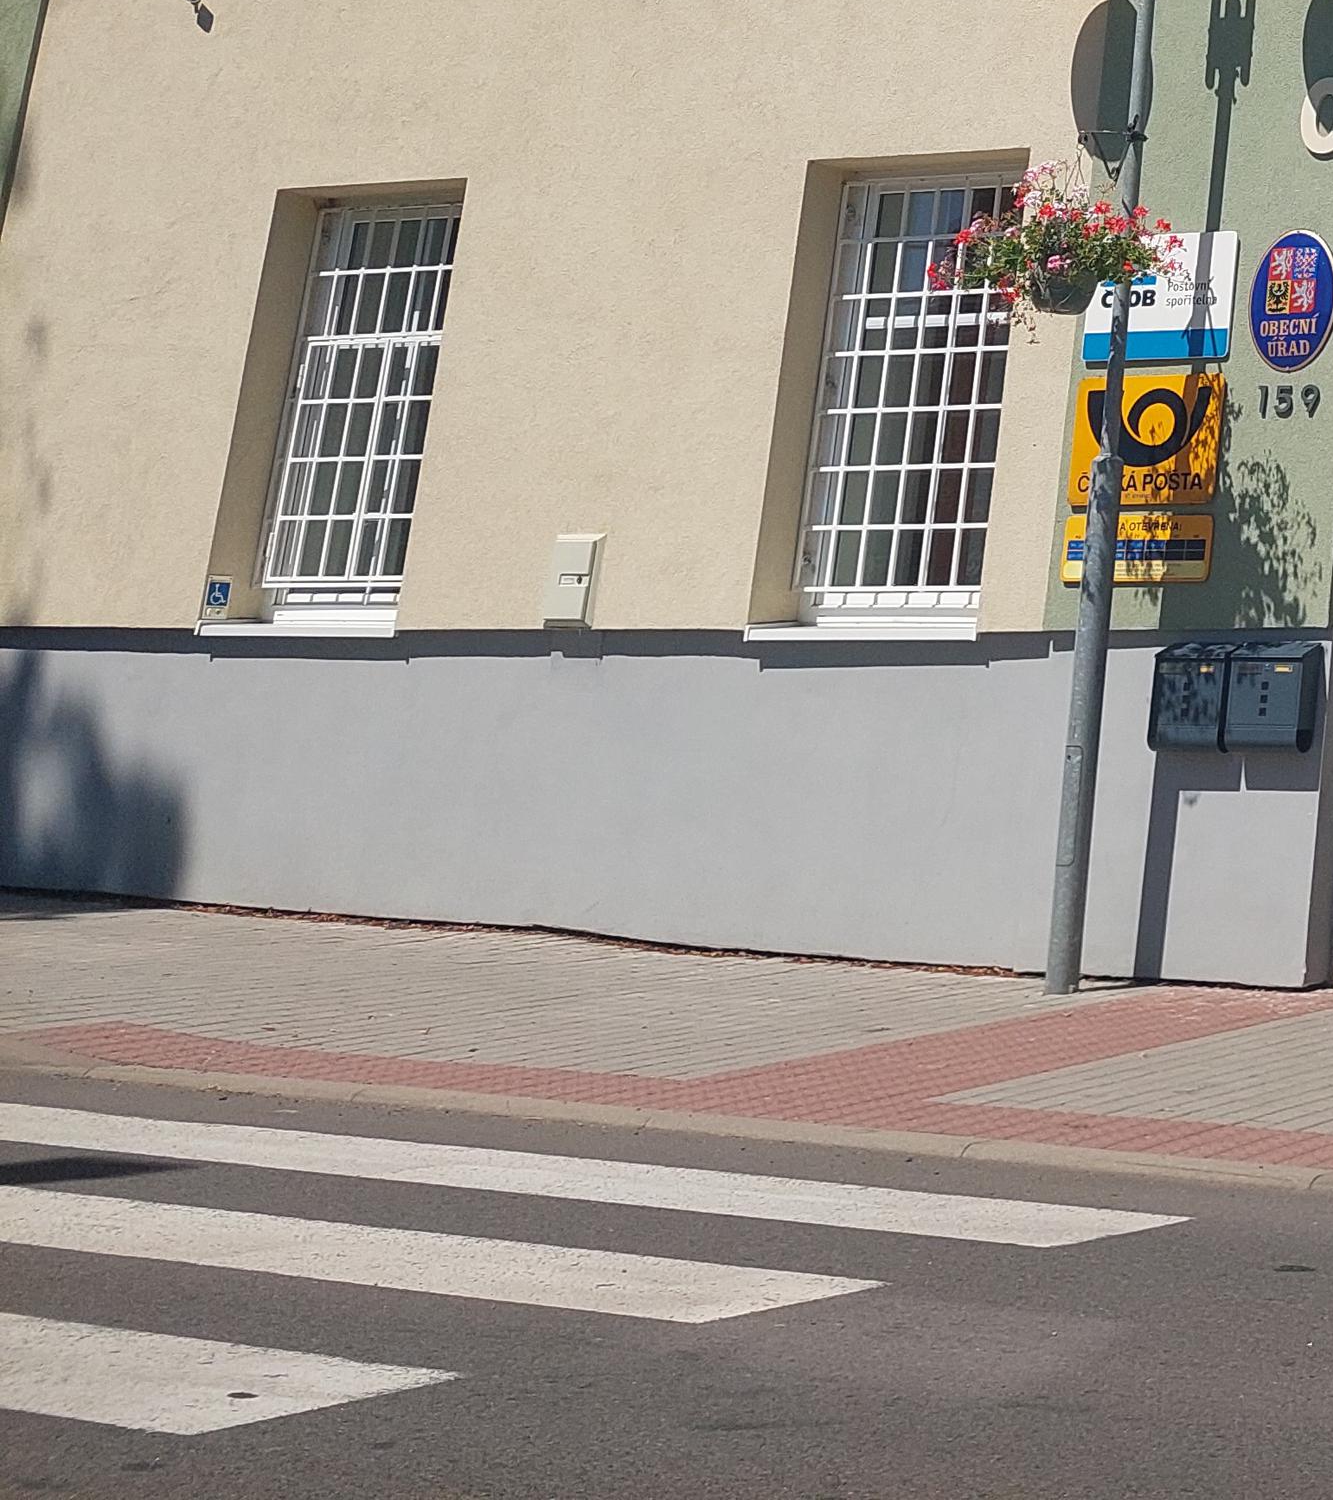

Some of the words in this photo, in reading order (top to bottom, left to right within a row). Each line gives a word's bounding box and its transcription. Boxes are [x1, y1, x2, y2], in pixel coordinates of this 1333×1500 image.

[1101, 288, 1157, 308] ČOB
[1260, 313, 1320, 337] OBECNÍ
[1267, 336, 1311, 358] ÚŘAD
[1258, 384, 1321, 419] 159
[1142, 468, 1203, 491] POŠTA
